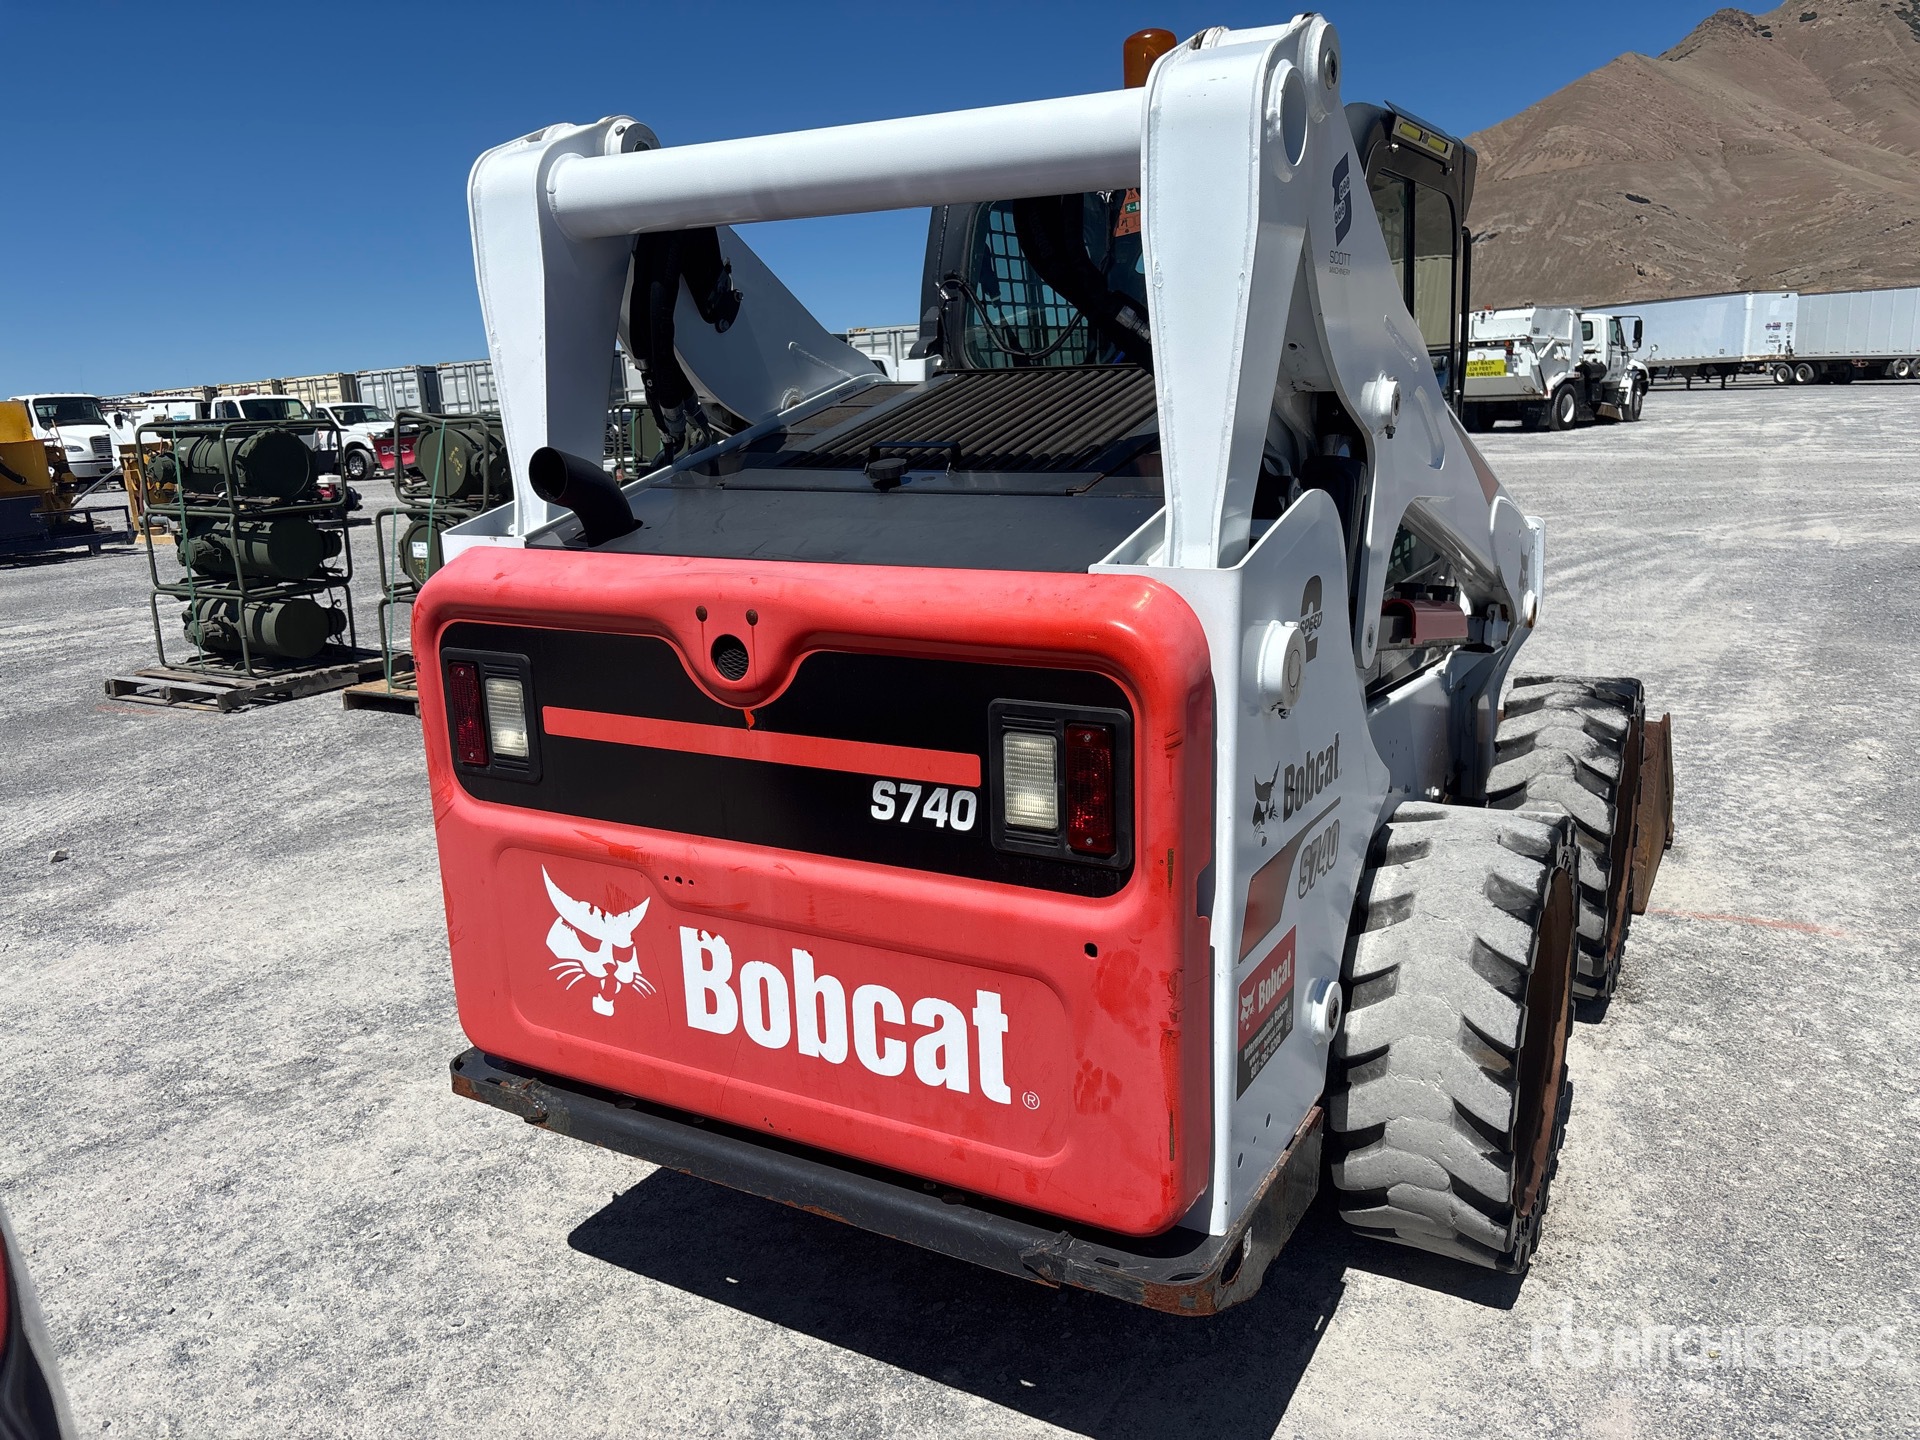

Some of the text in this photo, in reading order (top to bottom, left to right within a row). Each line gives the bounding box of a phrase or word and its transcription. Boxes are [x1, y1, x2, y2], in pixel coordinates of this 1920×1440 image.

[1329, 250, 1351, 266] SCOTT
[1300, 611, 1323, 636] SPEED
[871, 780, 978, 832] S740
[1283, 731, 1340, 823] Bobcat
[1298, 818, 1341, 900] S740
[1258, 949, 1292, 1014] Bobcat
[1274, 996, 1289, 1024] Bobcat
[678, 925, 1012, 1106] Bobcat
